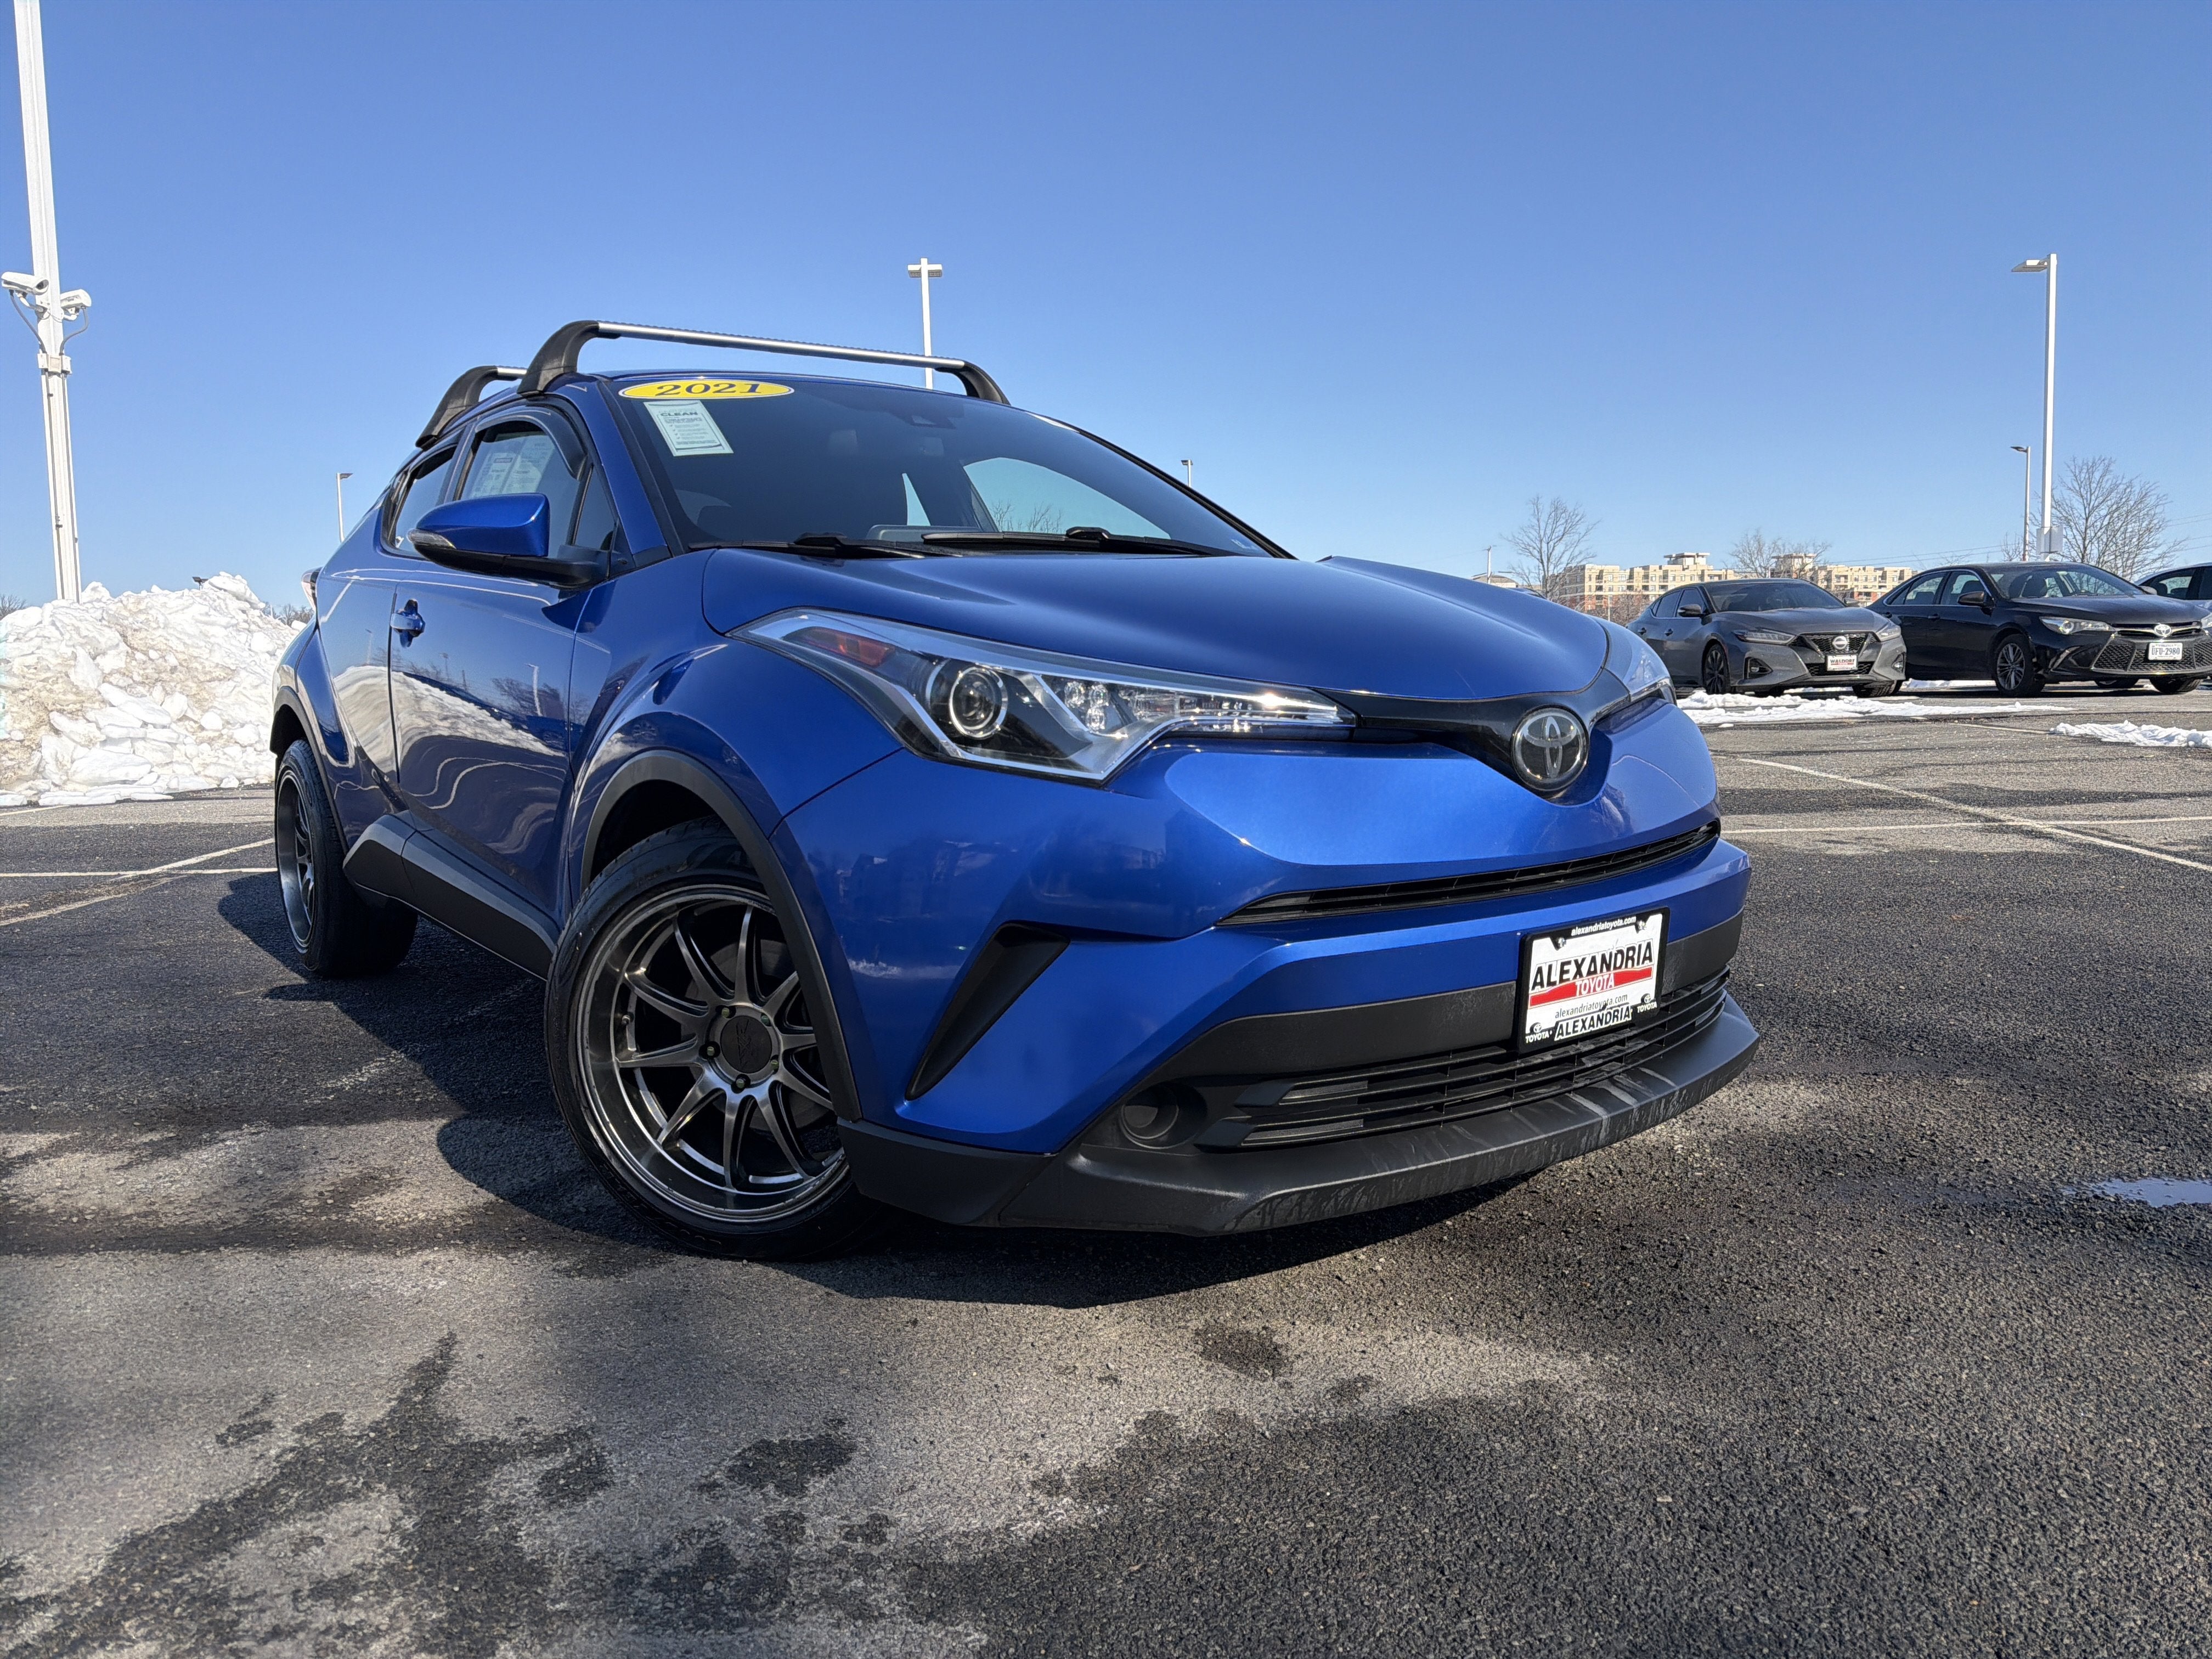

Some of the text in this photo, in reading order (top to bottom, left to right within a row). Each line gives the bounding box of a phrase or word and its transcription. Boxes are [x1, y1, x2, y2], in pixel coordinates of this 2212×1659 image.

[655, 383, 761, 396] 2021
[1571, 916, 1637, 936] alexandriatoyota.com
[1531, 941, 1653, 991] ALEXANDRIA
[1576, 973, 1615, 996] TOYOTA
[1555, 994, 1628, 1019] alexandriatoyota.com
[1525, 1001, 1657, 1043] TOYOTA ALEXANDRIA TOYOTA
